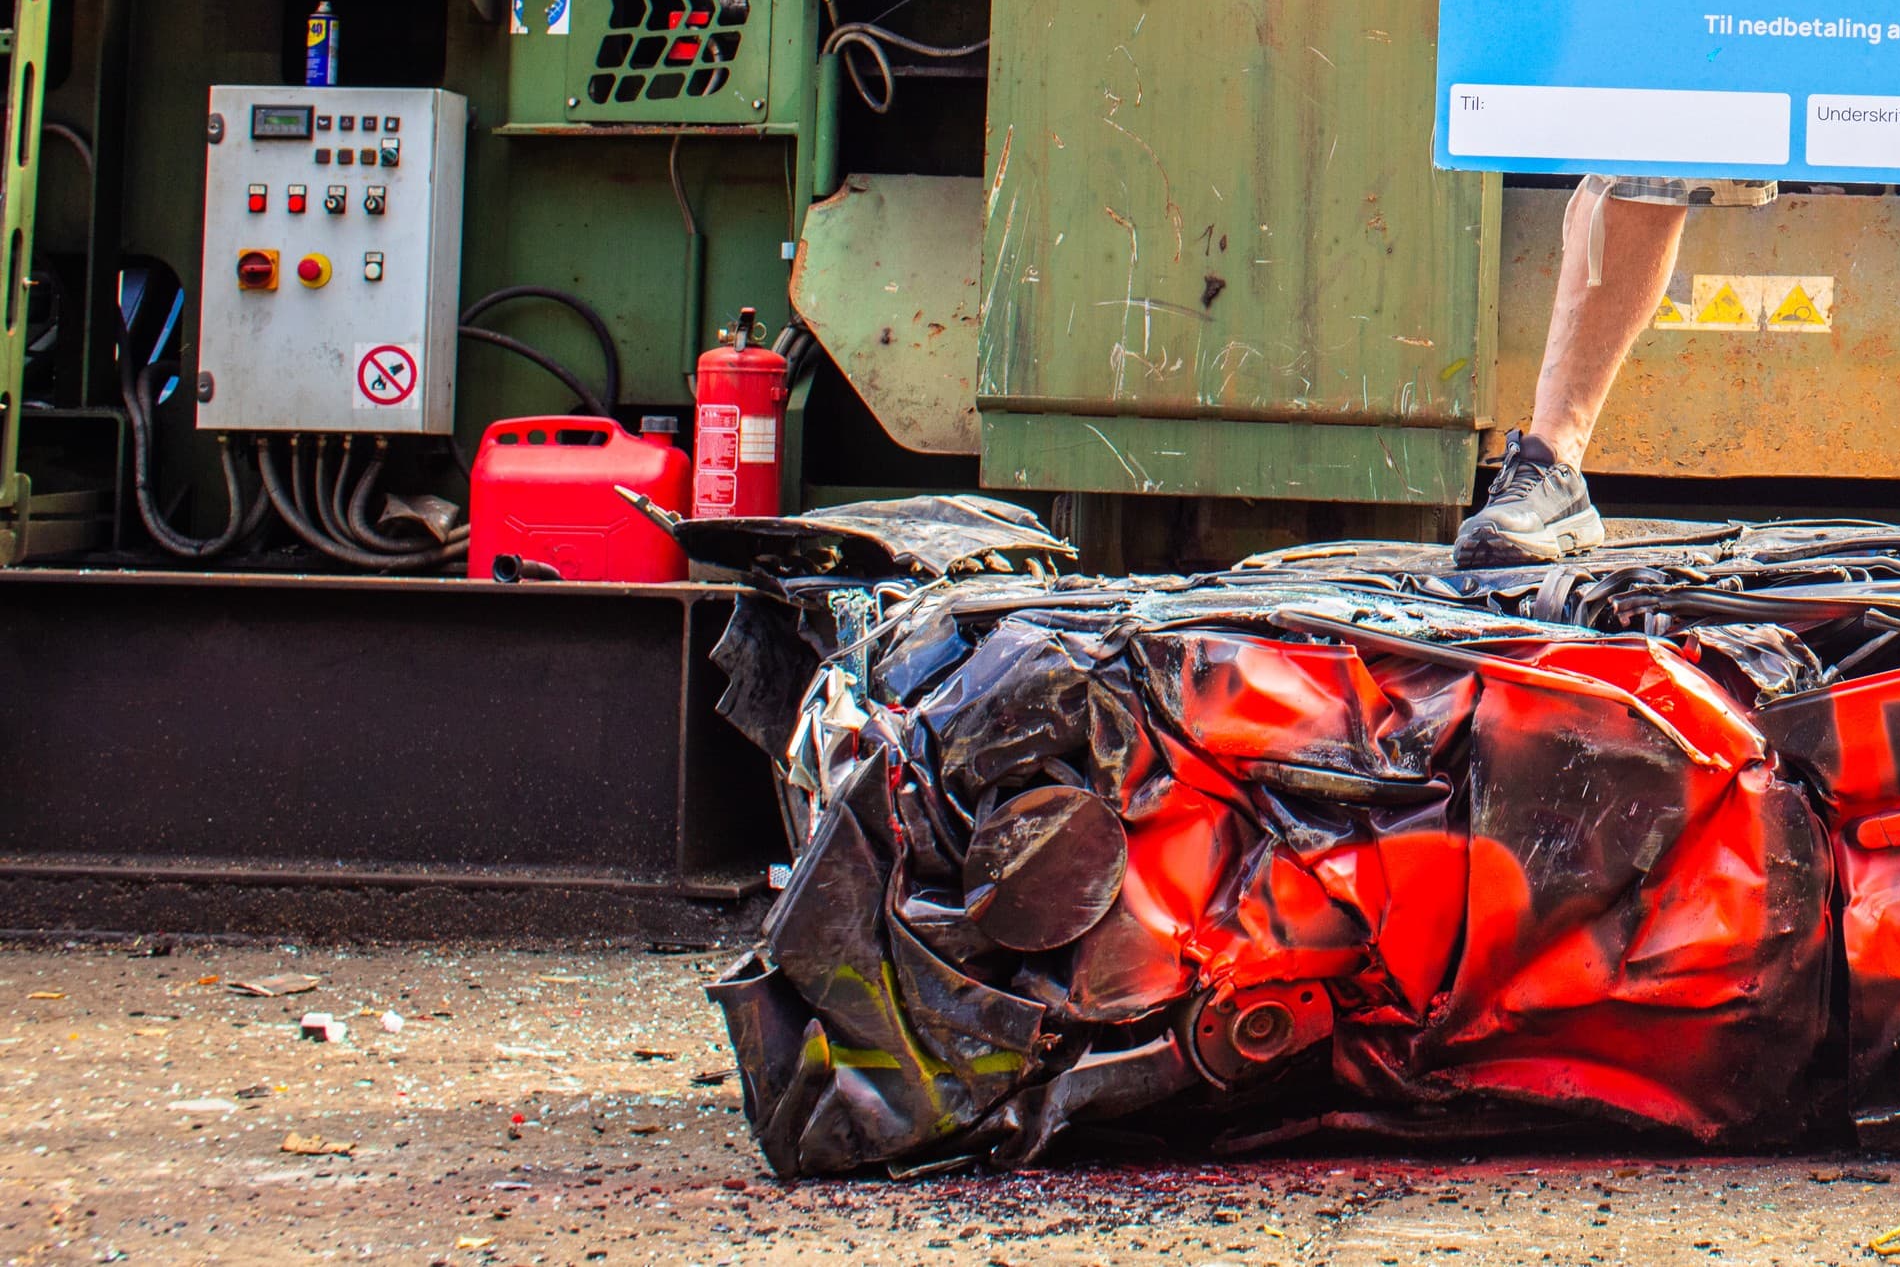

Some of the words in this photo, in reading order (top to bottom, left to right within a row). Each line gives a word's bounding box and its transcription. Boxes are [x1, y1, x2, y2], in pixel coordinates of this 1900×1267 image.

[1703, 14, 1733, 35] Til
[1738, 16, 1882, 45] nedbetaling
[1460, 95, 1485, 111] Til:
